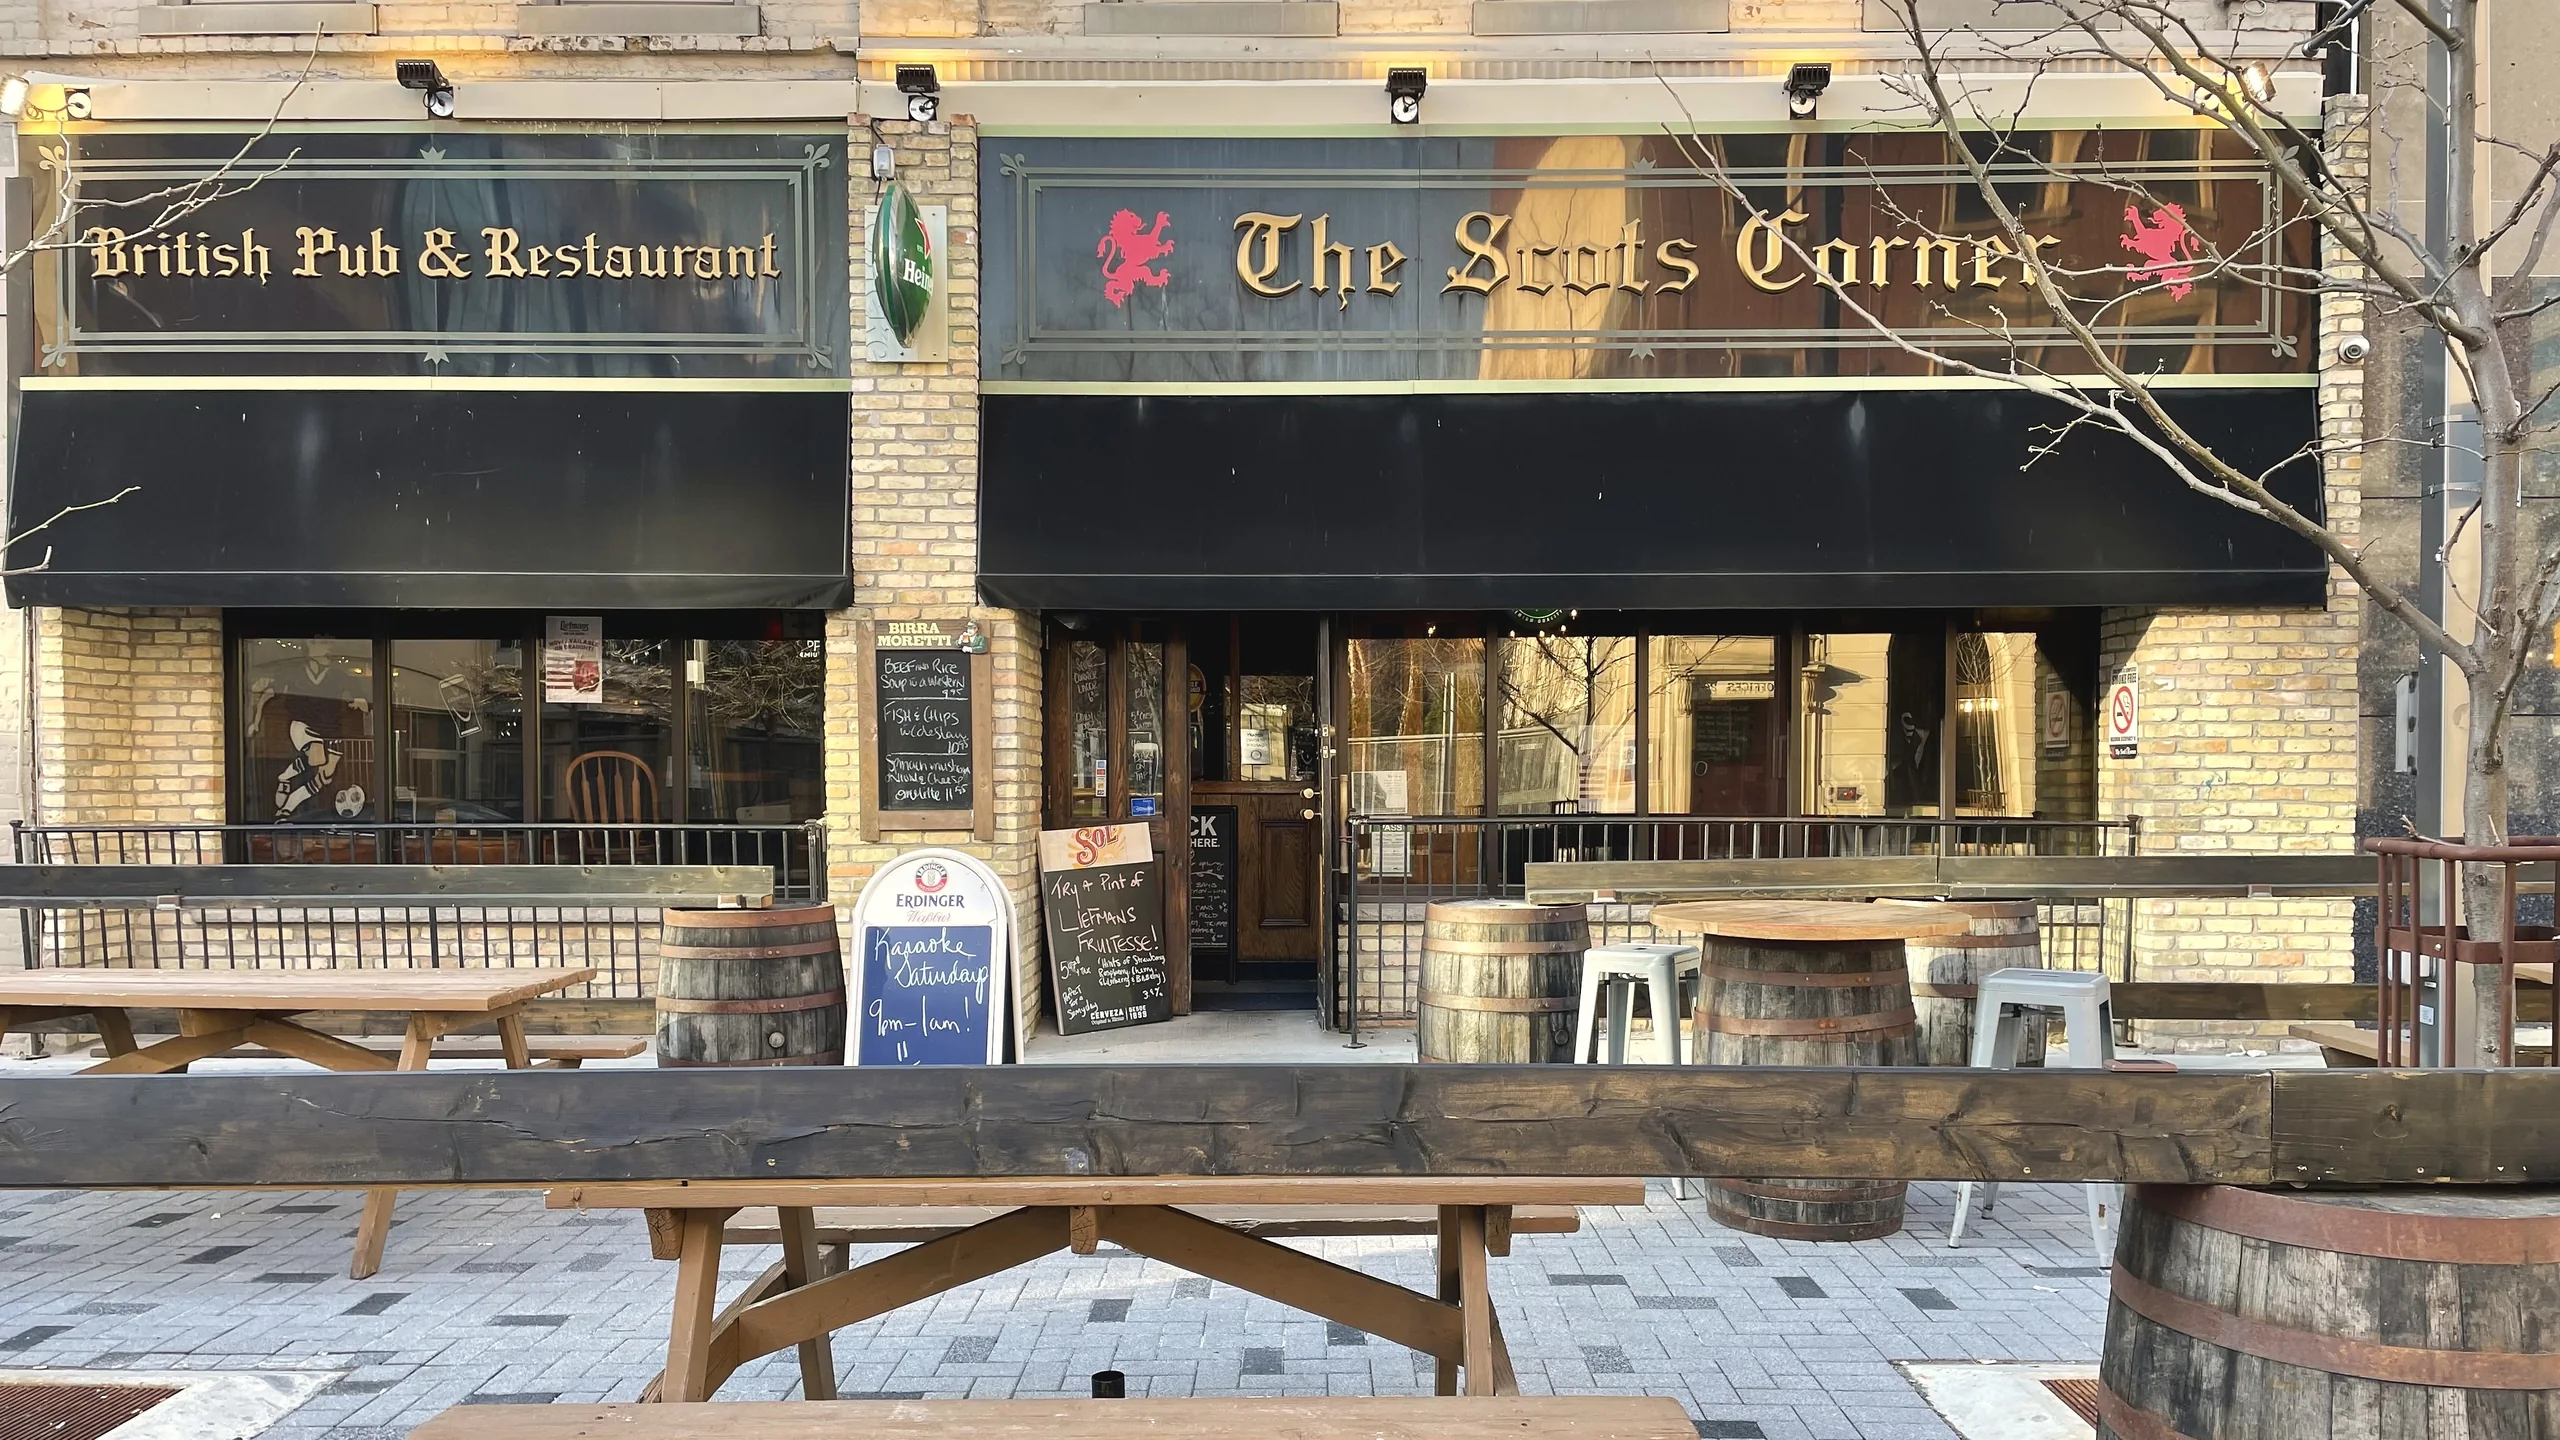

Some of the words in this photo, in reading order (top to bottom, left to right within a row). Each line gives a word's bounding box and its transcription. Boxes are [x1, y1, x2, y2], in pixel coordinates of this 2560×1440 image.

[88, 226, 271, 286] British
[291, 226, 401, 279] Pub
[418, 226, 471, 279] &
[484, 226, 783, 282] Restaurant
[1233, 211, 1408, 312] The
[1440, 210, 1700, 298] Scots
[1735, 207, 2062, 295] Corner
[888, 622, 940, 635] BIRRA
[877, 635, 951, 648] MORETTI
[880, 674, 908, 692] Soup
[883, 700, 912, 724] FISH
[1380, 824, 1403, 832] ASS
[895, 893, 965, 909] ERDINGER
[1057, 906, 1138, 933] LIEFMANS
[874, 926, 977, 970] Karaoke
[1090, 1008, 1125, 1020] CERVEZA
